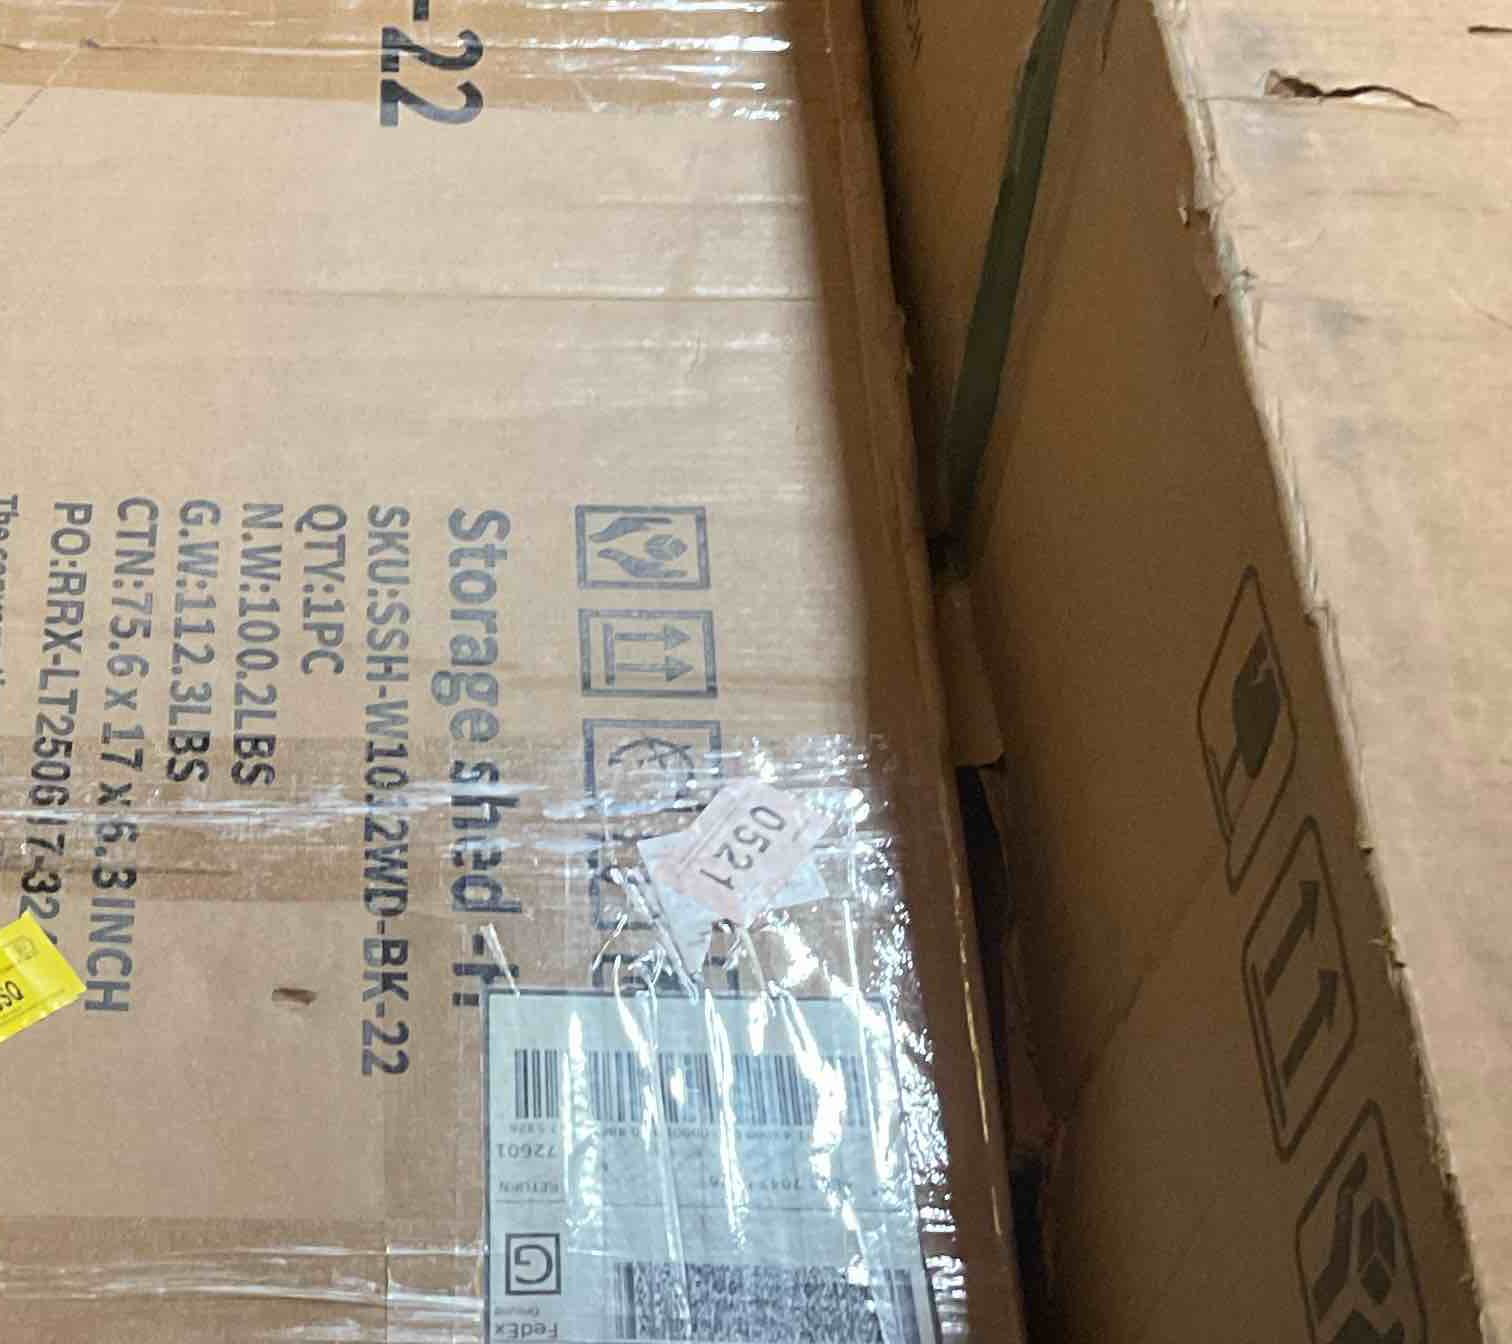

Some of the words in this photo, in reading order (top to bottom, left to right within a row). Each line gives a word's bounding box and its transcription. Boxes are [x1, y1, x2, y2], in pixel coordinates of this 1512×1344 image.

[106, 496, 158, 678] CTN:75.6
[166, 498, 220, 783] G.W:112.3LBS
[230, 502, 284, 786] N.W:100.2LBS
[293, 503, 347, 676] QTY:1PC
[430, 507, 511, 743] Storage
[18, 501, 92, 945] PO:RRX-LT250617-32
[98, 721, 145, 772] 17
[450, 760, 521, 914] shed
[699, 806, 785, 891] 0521
[495, 1142, 556, 1157] 72601
[493, 1321, 557, 1338] FedEx
[512, 1243, 553, 1284] G
